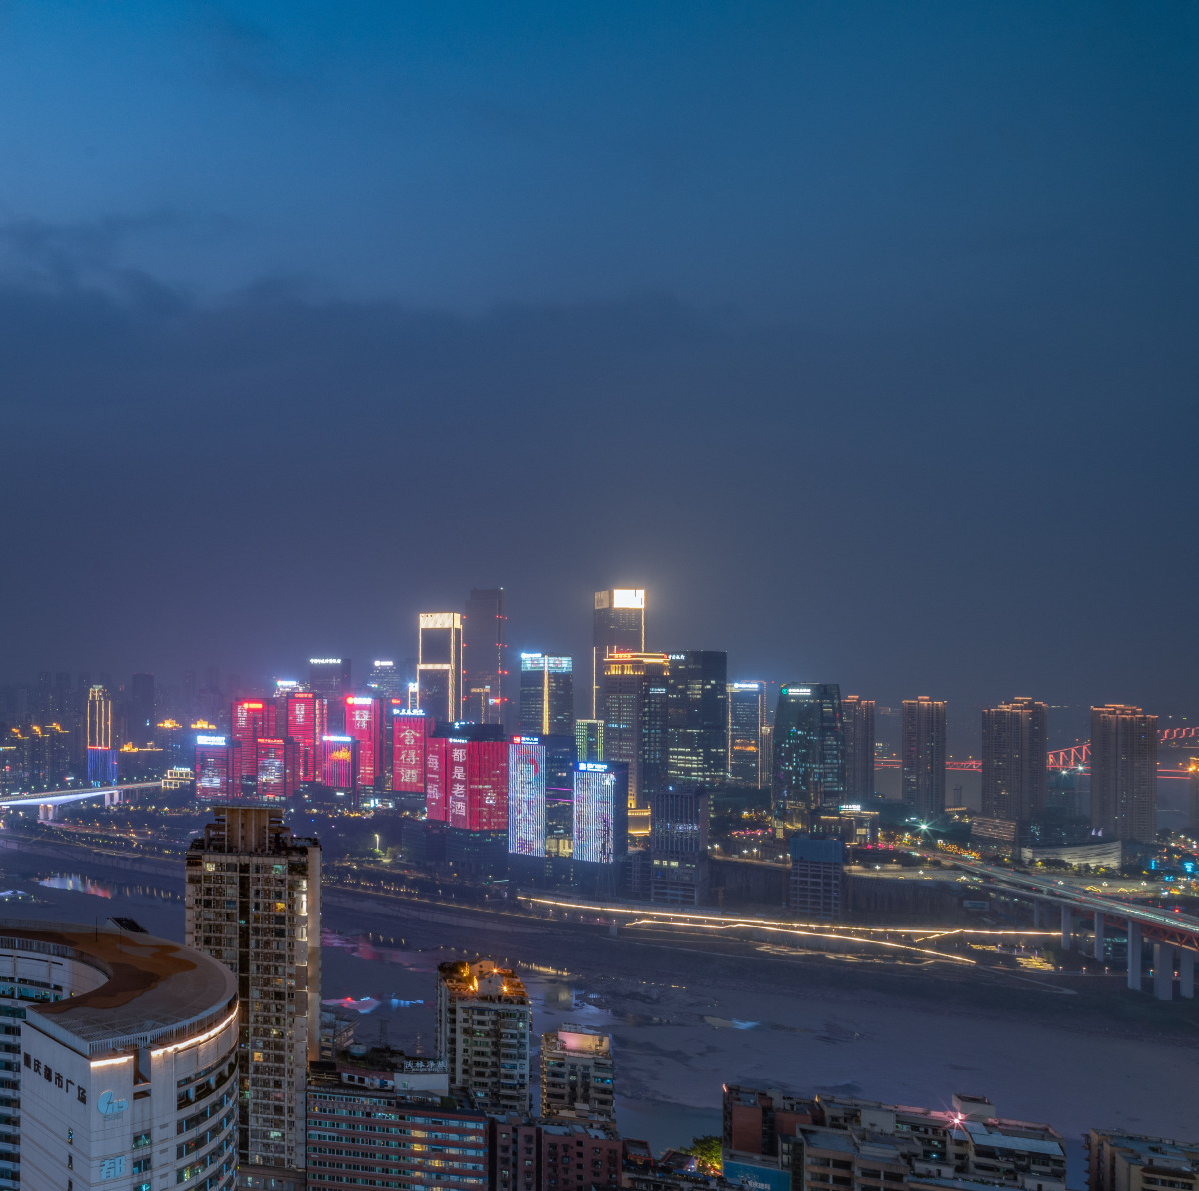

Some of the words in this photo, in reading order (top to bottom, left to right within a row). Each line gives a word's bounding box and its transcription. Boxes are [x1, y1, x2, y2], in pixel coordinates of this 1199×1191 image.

[399, 728, 420, 783] 舍得酒
[427, 753, 439, 799] 每一瓶
[451, 747, 467, 816] 都是老酒
[24, 1052, 86, 1104] 重庆都市广场
